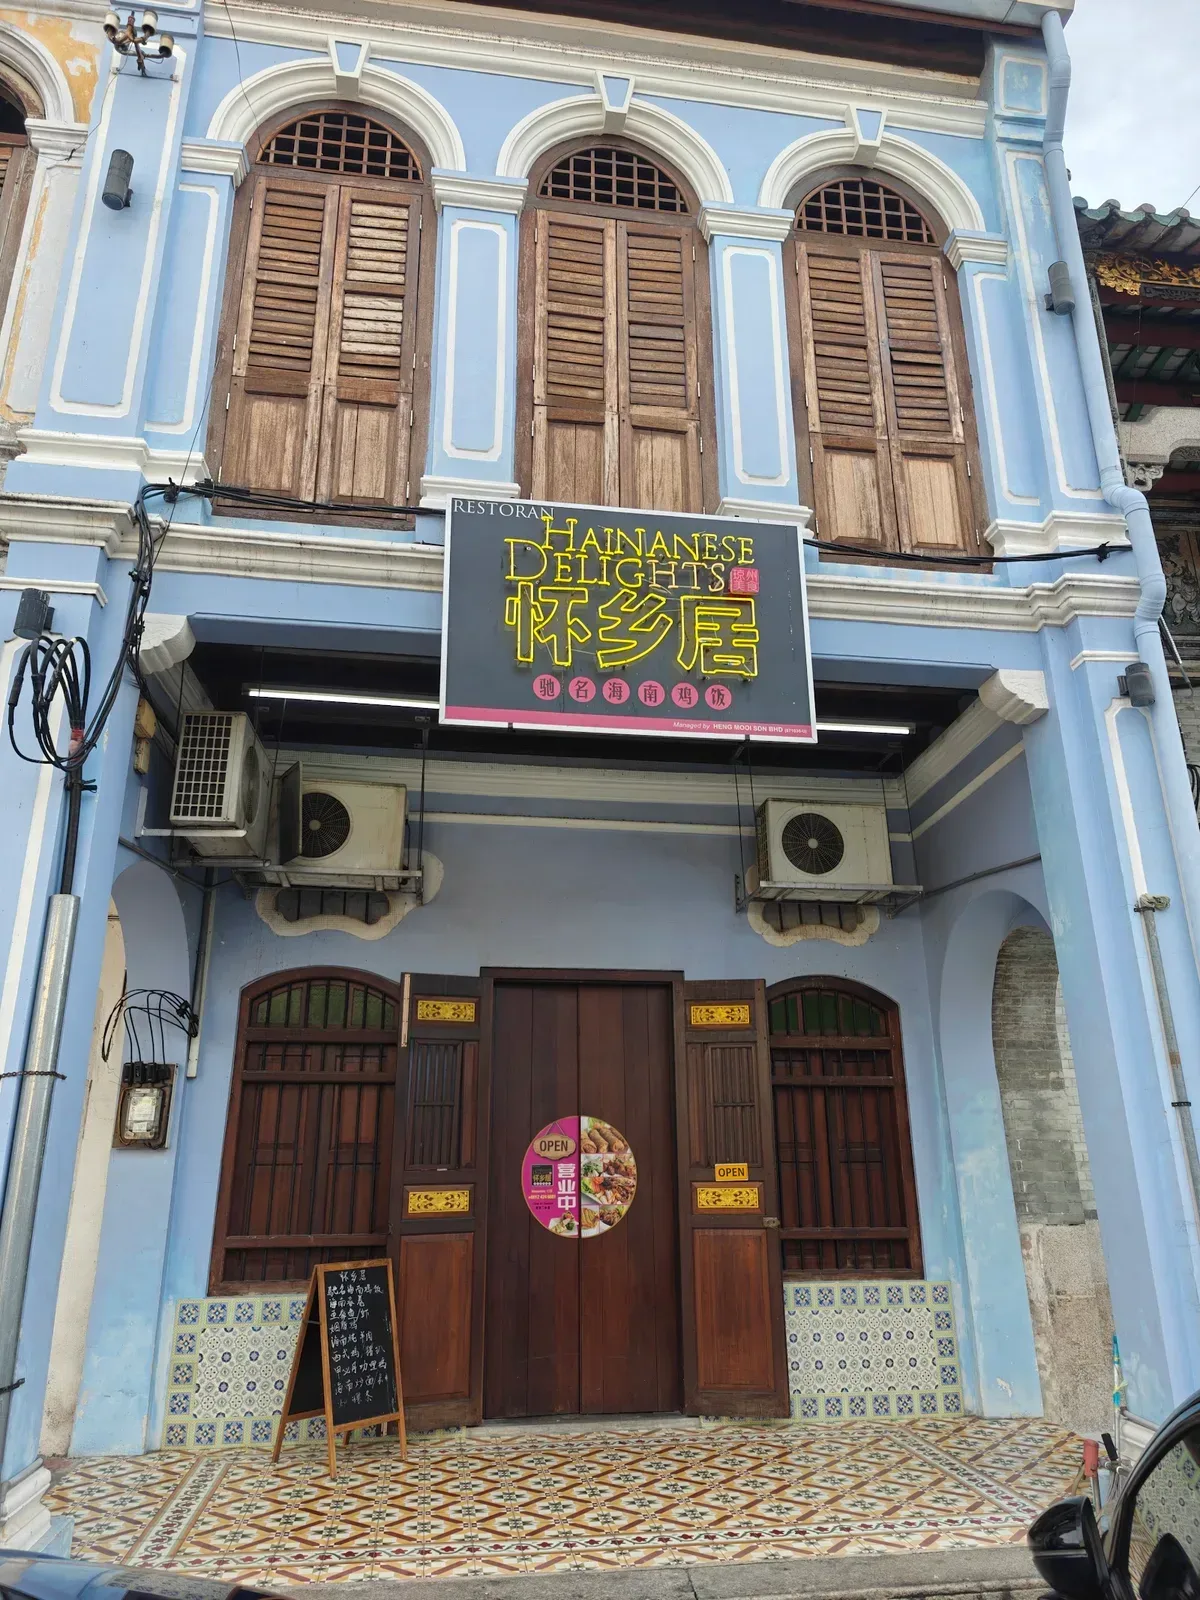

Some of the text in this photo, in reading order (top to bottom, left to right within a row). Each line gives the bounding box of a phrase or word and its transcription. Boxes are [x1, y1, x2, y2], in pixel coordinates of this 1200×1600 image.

[453, 499, 555, 521] RESTORAN
[541, 516, 755, 565] HAINANESE
[504, 538, 725, 592] DELIGHTS
[505, 581, 760, 676] 怀乡居
[538, 677, 727, 707] 驰名海南鸡饭
[673, 721, 702, 730] Managed
[702, 723, 710, 731] by
[713, 723, 733, 731] HENG
[733, 724, 752, 732] MOOI
[539, 1139, 569, 1152] OPEN
[557, 1163, 576, 1211] 营业中
[718, 1167, 745, 1177] OPEN
